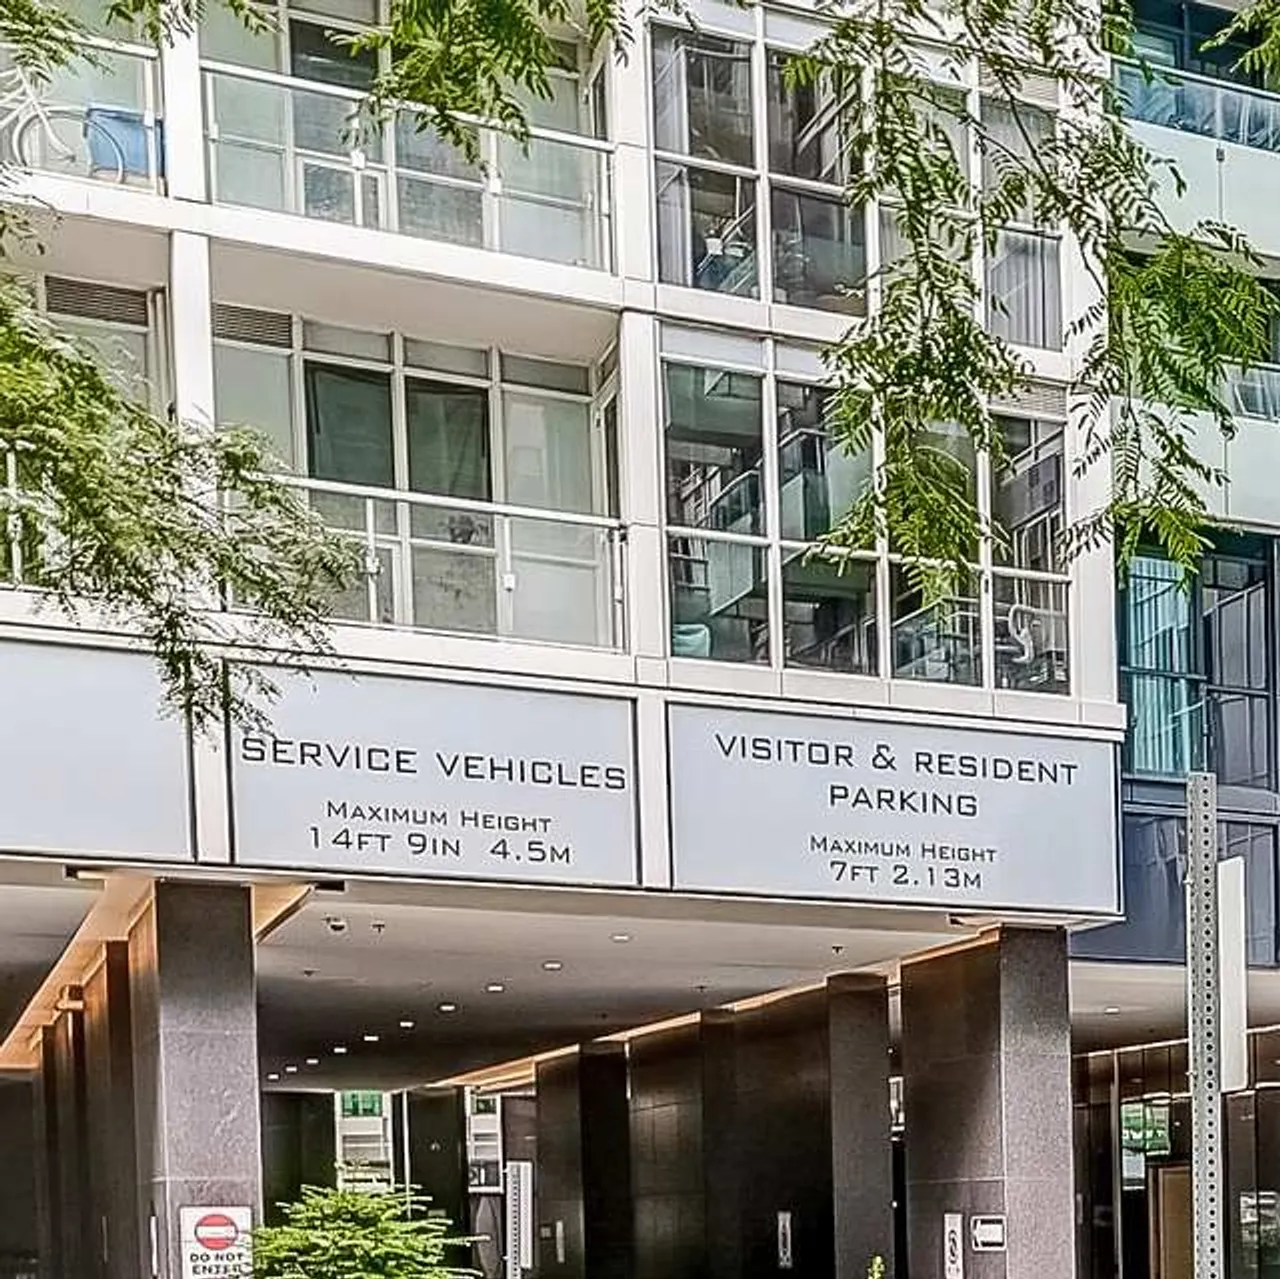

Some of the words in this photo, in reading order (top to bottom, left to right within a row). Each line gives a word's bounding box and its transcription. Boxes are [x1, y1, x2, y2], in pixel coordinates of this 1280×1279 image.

[241, 737, 418, 774] SERVICE
[435, 752, 627, 791] VEHICLES
[715, 733, 854, 768] VISITOR
[871, 743, 898, 772] &
[914, 751, 1079, 786] RESIDENT
[326, 800, 448, 826] MAXIMUM
[460, 810, 552, 833] HEIGHT
[829, 784, 978, 817] PARKING
[309, 826, 393, 853] 14FT
[406, 832, 461, 858] 9IN
[489, 838, 571, 864] 4.5M
[809, 834, 911, 858] MAXIMUM
[920, 842, 998, 863] HEIGHT
[829, 860, 880, 884] 7FT
[892, 864, 982, 890] 2.13M
[189, 1252, 211, 1263] DO
